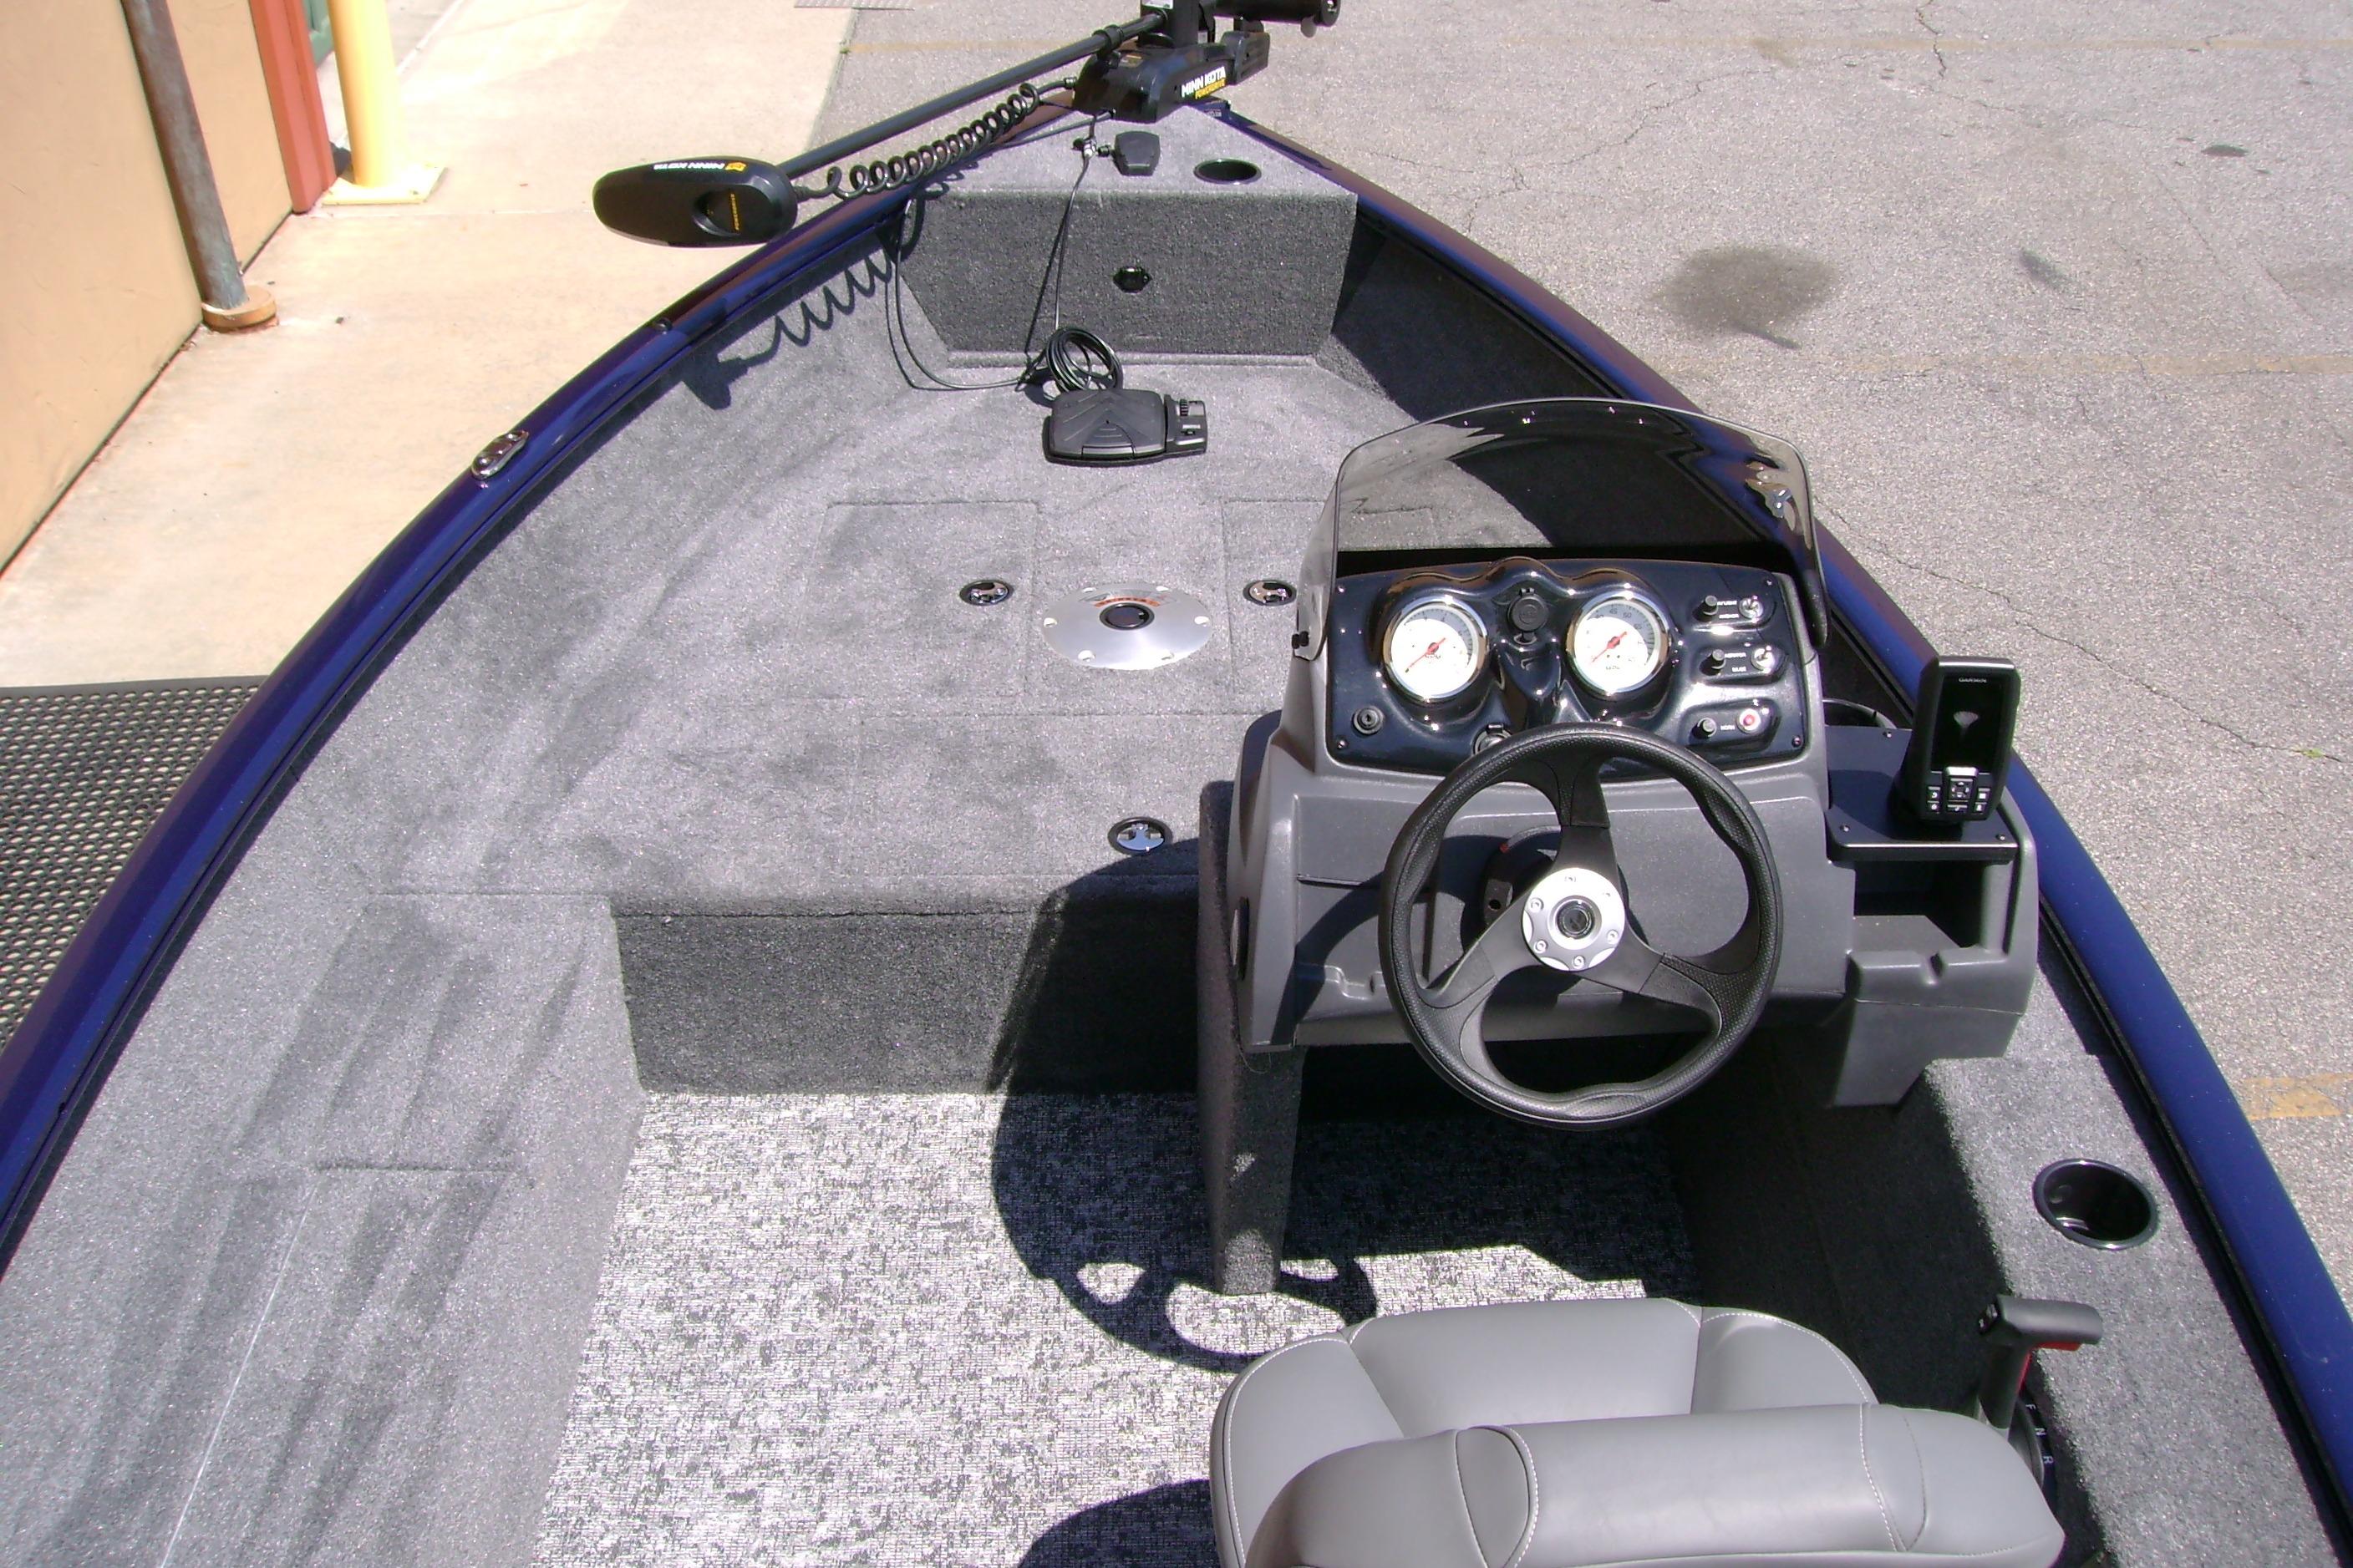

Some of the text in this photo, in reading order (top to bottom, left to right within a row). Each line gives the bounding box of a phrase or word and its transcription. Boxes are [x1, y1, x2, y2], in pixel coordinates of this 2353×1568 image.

[1181, 66, 1226, 98] MINN KOTA
[2043, 1455, 2054, 1464] R
